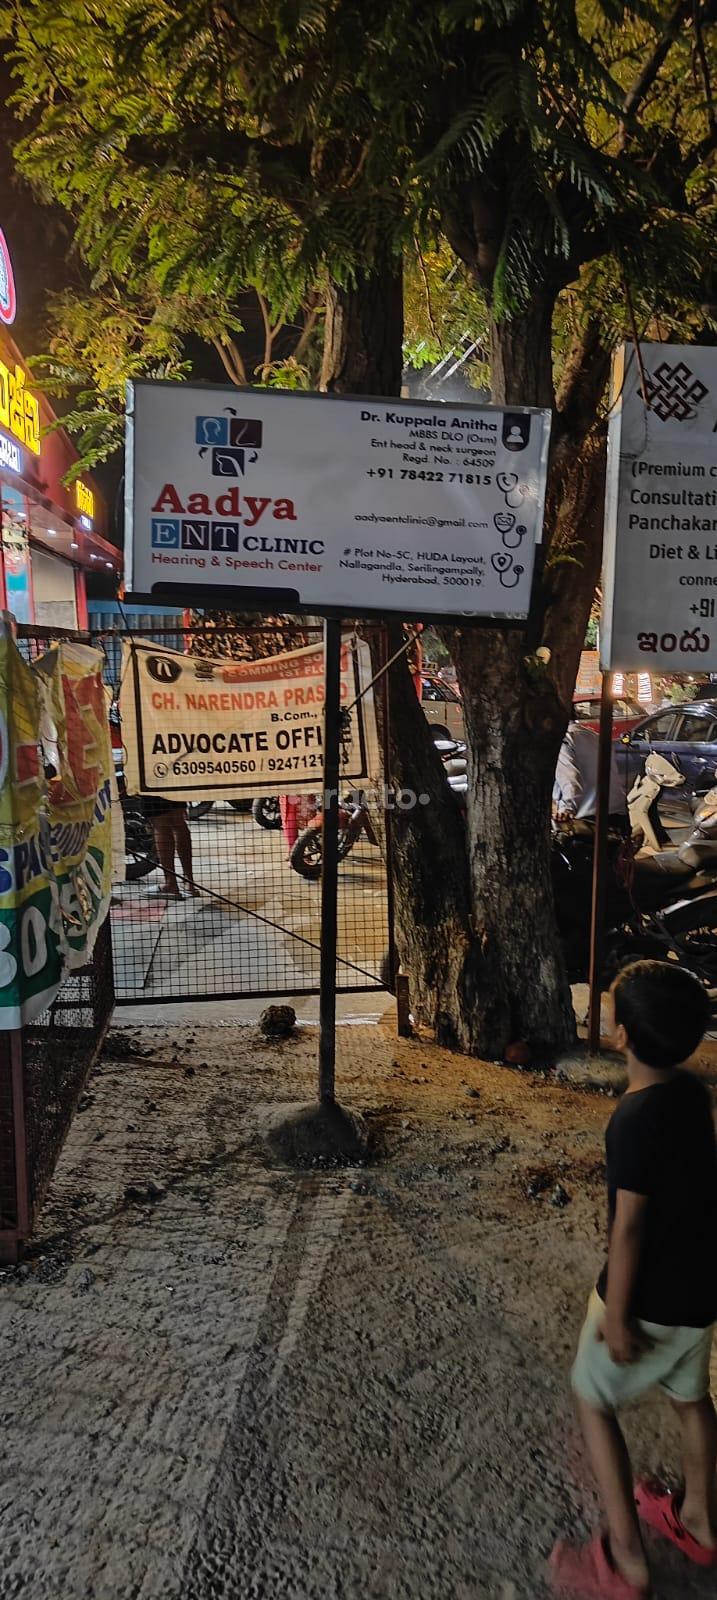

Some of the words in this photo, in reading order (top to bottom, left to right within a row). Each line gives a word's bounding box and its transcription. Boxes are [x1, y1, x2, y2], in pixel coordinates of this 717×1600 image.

[361, 411, 380, 422] Dr.
[386, 413, 446, 427] Kuppala
[451, 417, 497, 431] Anitha
[409, 430, 438, 440] MBBS
[441, 431, 463, 442] DLO
[467, 434, 497, 444] (Osm)
[371, 439, 388, 449] Ent
[390, 440, 416, 451] head
[418, 441, 426, 452] &
[430, 444, 453, 454] neck
[456, 446, 496, 457] surgeon
[402, 454, 429, 464] Regd.
[434, 455, 452, 465] No.
[463, 458, 495, 468] 64509
[631, 461, 706, 478] (Premium
[366, 468, 393, 479] +91
[400, 470, 444, 482] 78422
[449, 472, 491, 485] 71815
[151, 483, 297, 526] Aadya
[354, 513, 489, 529] aadyaentclinic@gmail.com
[152, 519, 238, 550] ENT
[243, 536, 325, 555] CLINIC
[354, 548, 374, 558] Plot
[417, 552, 449, 563] HUDA
[451, 553, 486, 565] Layout,
[649, 544, 684, 560] Diet
[687, 545, 700, 560] &
[152, 553, 206, 568] Hearing
[211, 556, 221, 567] &
[225, 556, 274, 571] Speech
[278, 559, 322, 573] Center
[382, 573, 440, 586] Hyderabad,
[689, 598, 715, 617] +91
[637, 627, 711, 653] ఇందు
[280, 668, 300, 678] 1ST
[152, 692, 180, 710] CH.
[185, 690, 279, 711] NARENDRA
[284, 683, 348, 707] PRASD
[152, 731, 268, 755] ADVOCATE
[173, 760, 255, 775] 6309540560
